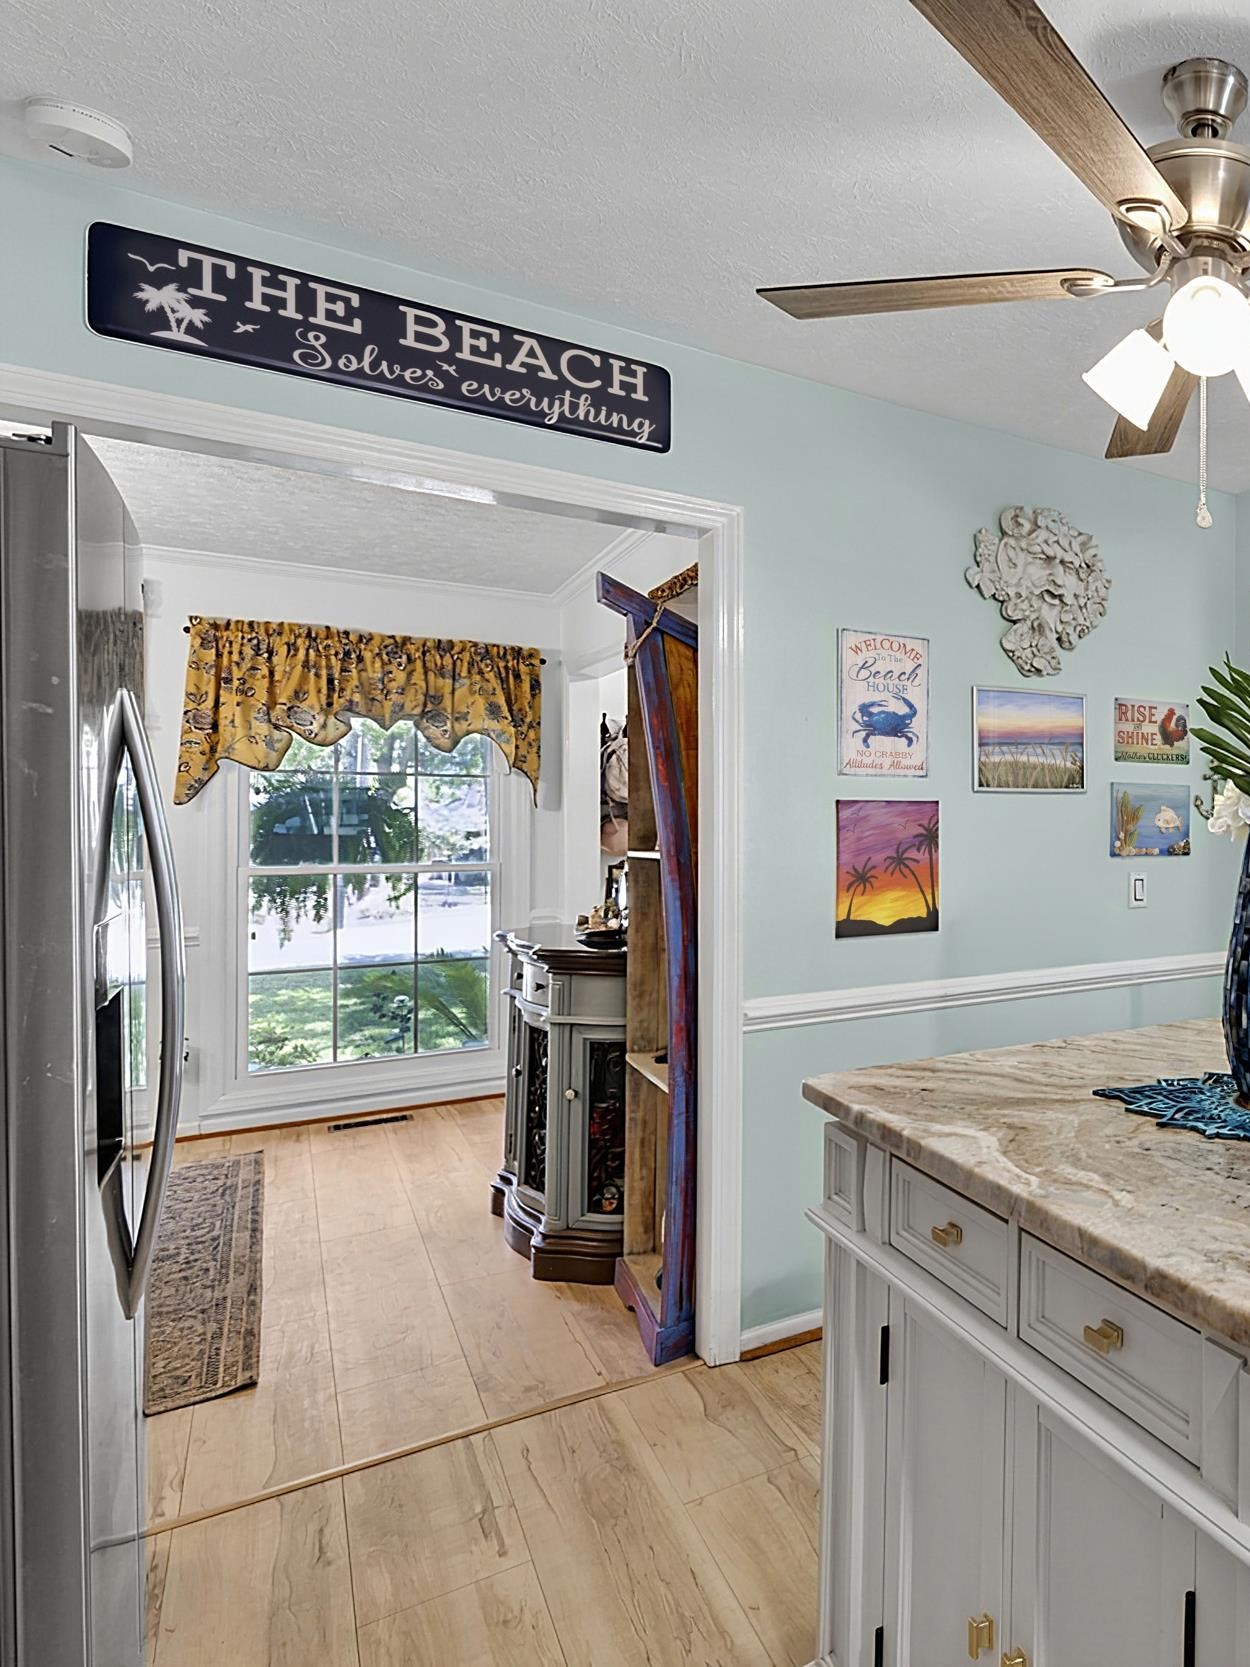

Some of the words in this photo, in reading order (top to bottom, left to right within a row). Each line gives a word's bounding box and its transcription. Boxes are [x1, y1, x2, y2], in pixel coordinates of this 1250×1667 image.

[178, 248, 362, 335] THE
[398, 305, 649, 401] BEACH
[293, 328, 445, 390] Solves
[461, 378, 656, 443] everything
[849, 638, 923, 664] WELCOME
[876, 653, 886, 661] To
[887, 654, 904, 663] The
[848, 656, 923, 687] Beach
[866, 681, 909, 695] HOUSE
[1118, 703, 1158, 724] RISE
[1117, 730, 1158, 746] SHINE
[856, 750, 872, 758] NO
[874, 750, 914, 759] CRABBY
[843, 757, 884, 770] Attitudes
[888, 760, 925, 771] Allowed
